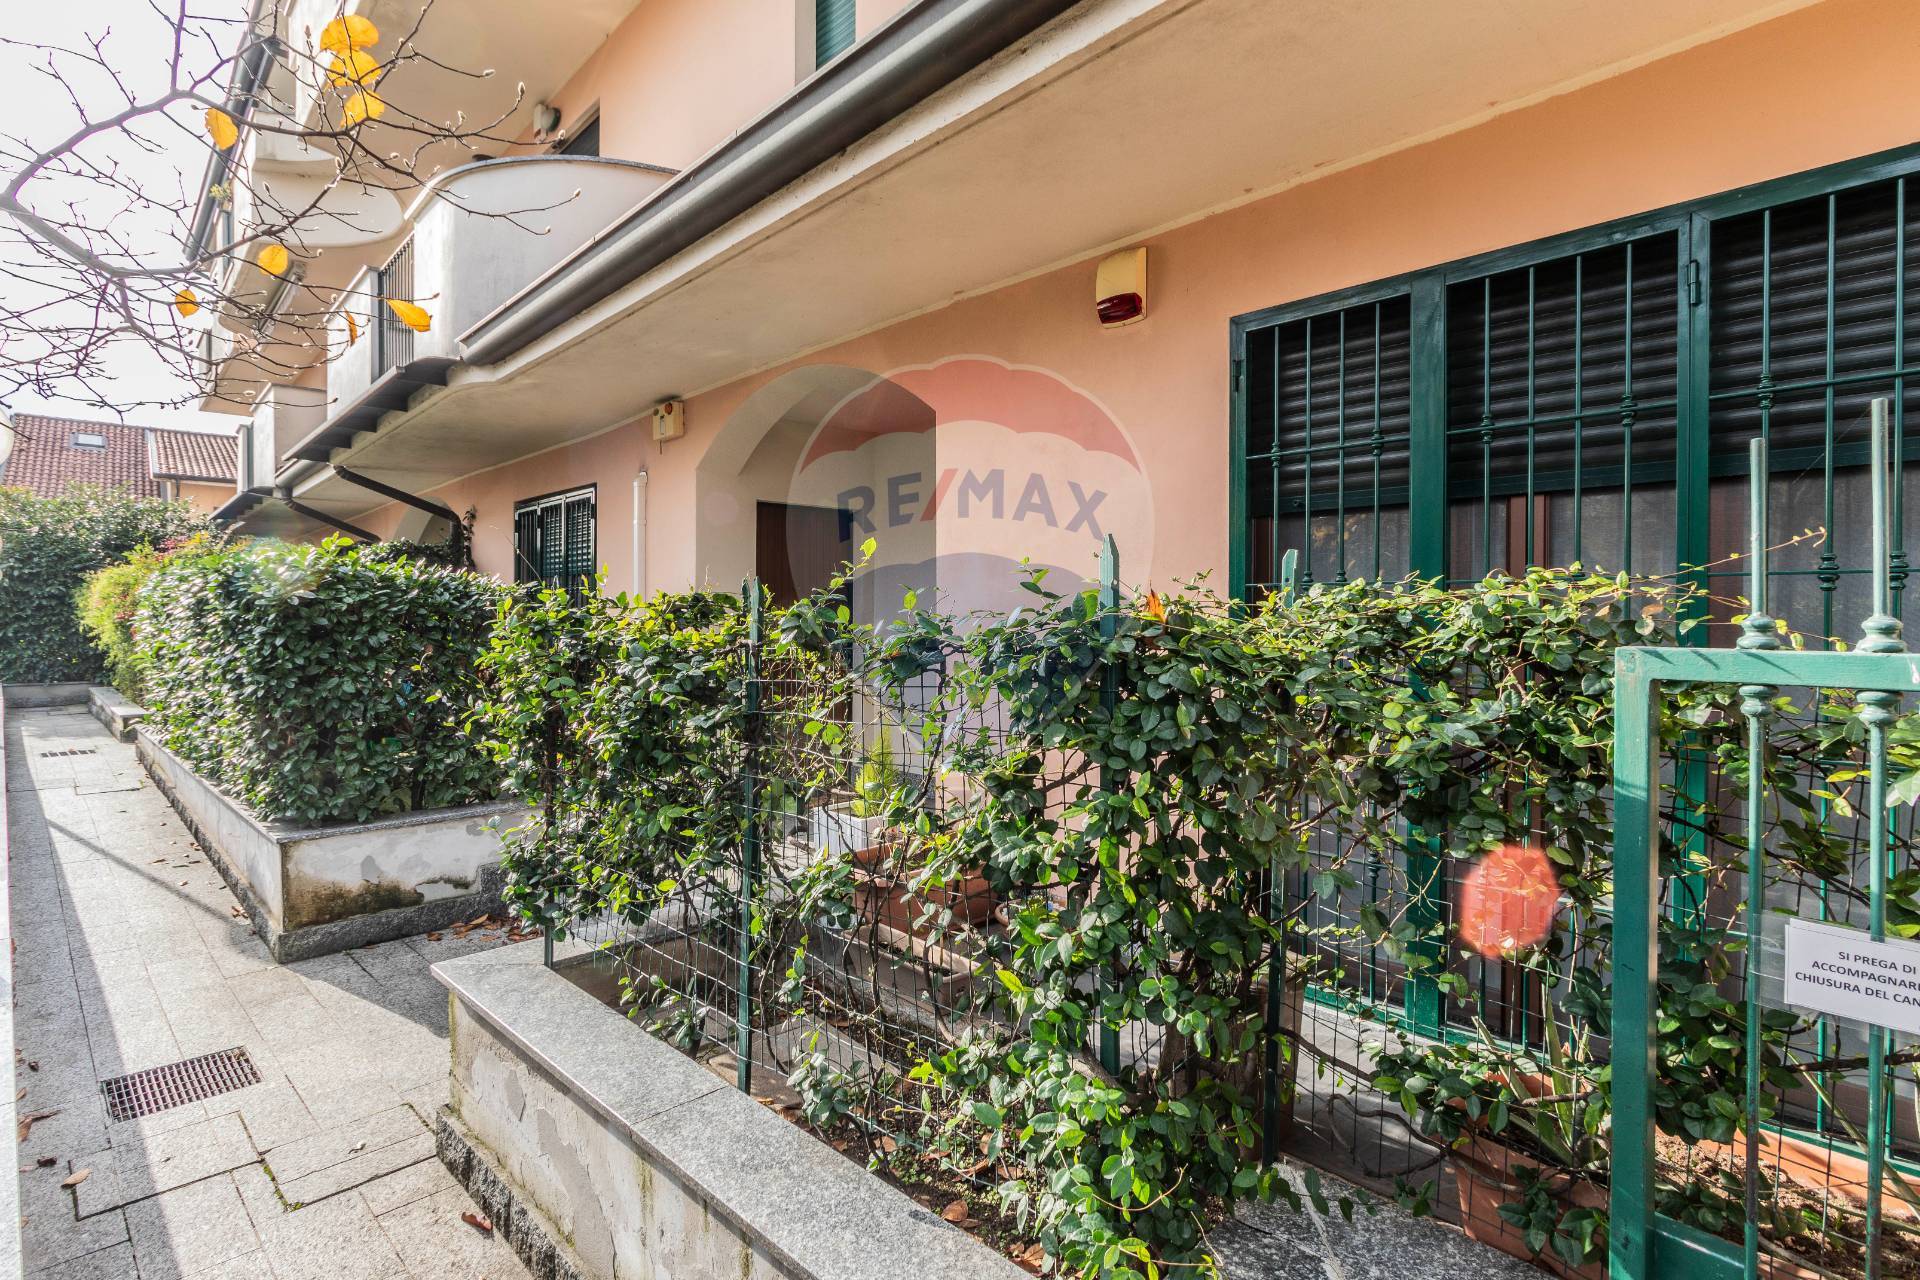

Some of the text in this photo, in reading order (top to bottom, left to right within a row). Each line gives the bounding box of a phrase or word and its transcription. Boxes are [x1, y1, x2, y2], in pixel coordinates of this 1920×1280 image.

[1838, 951, 1917, 975] SI PREGA DI
[1795, 972, 1861, 994] CHIUSURA
[1865, 987, 1890, 1001] DEL
